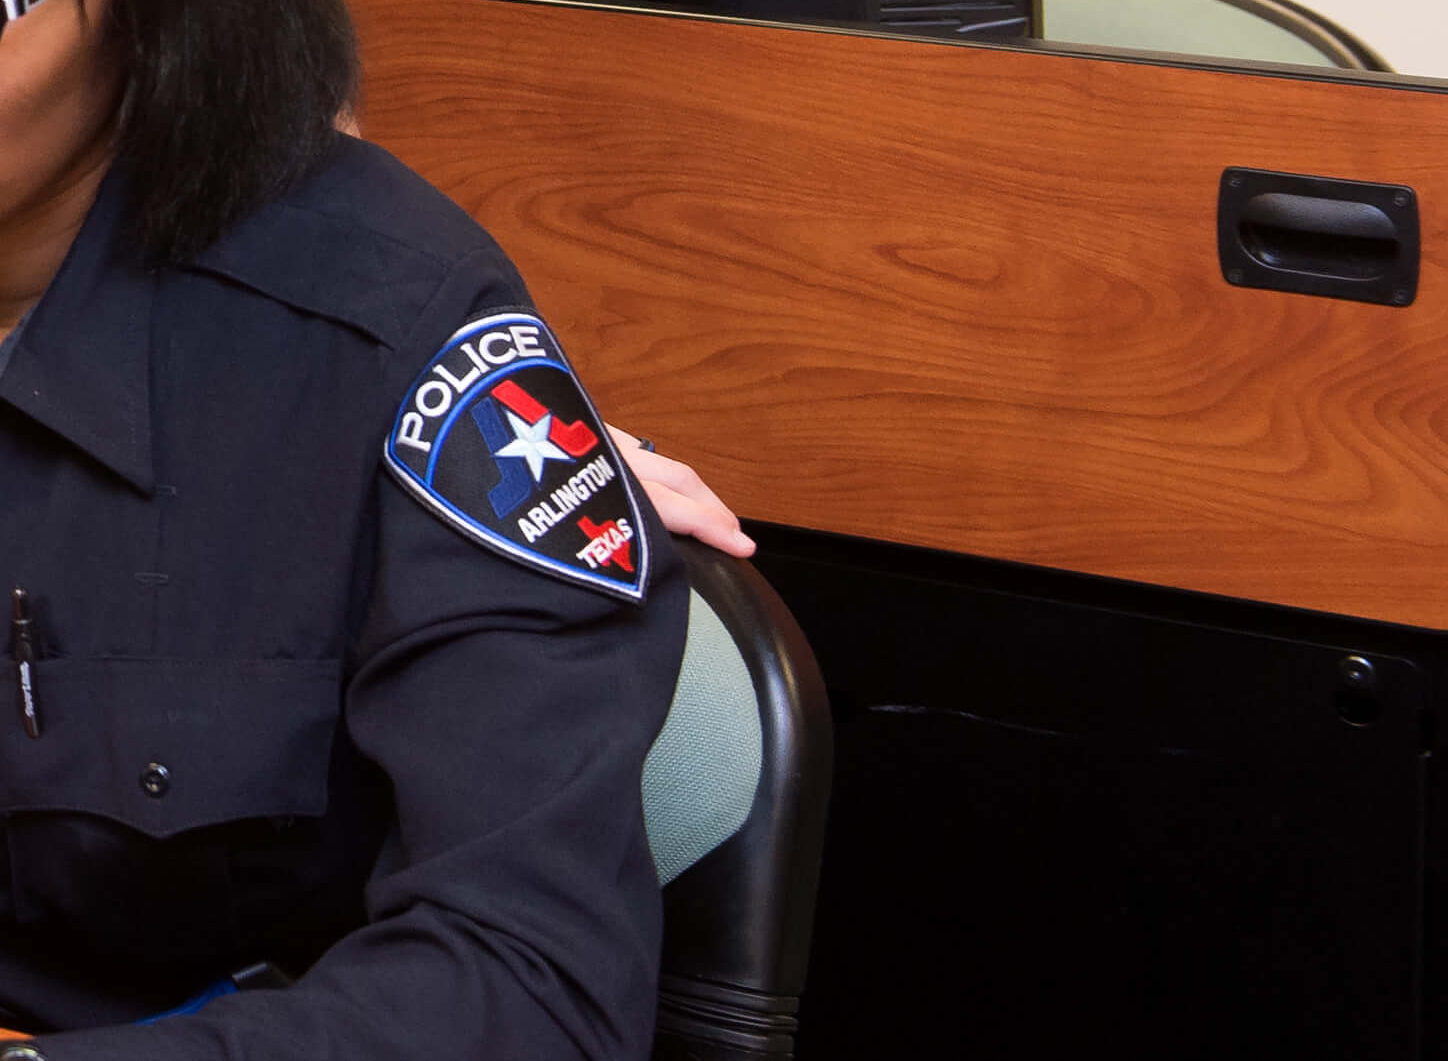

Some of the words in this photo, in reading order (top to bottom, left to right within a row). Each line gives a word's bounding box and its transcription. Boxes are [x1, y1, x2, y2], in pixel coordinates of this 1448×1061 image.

[396, 325, 547, 453] POLICE
[516, 455, 616, 544] ARLINGTON
[576, 517, 634, 570] TEXAS
